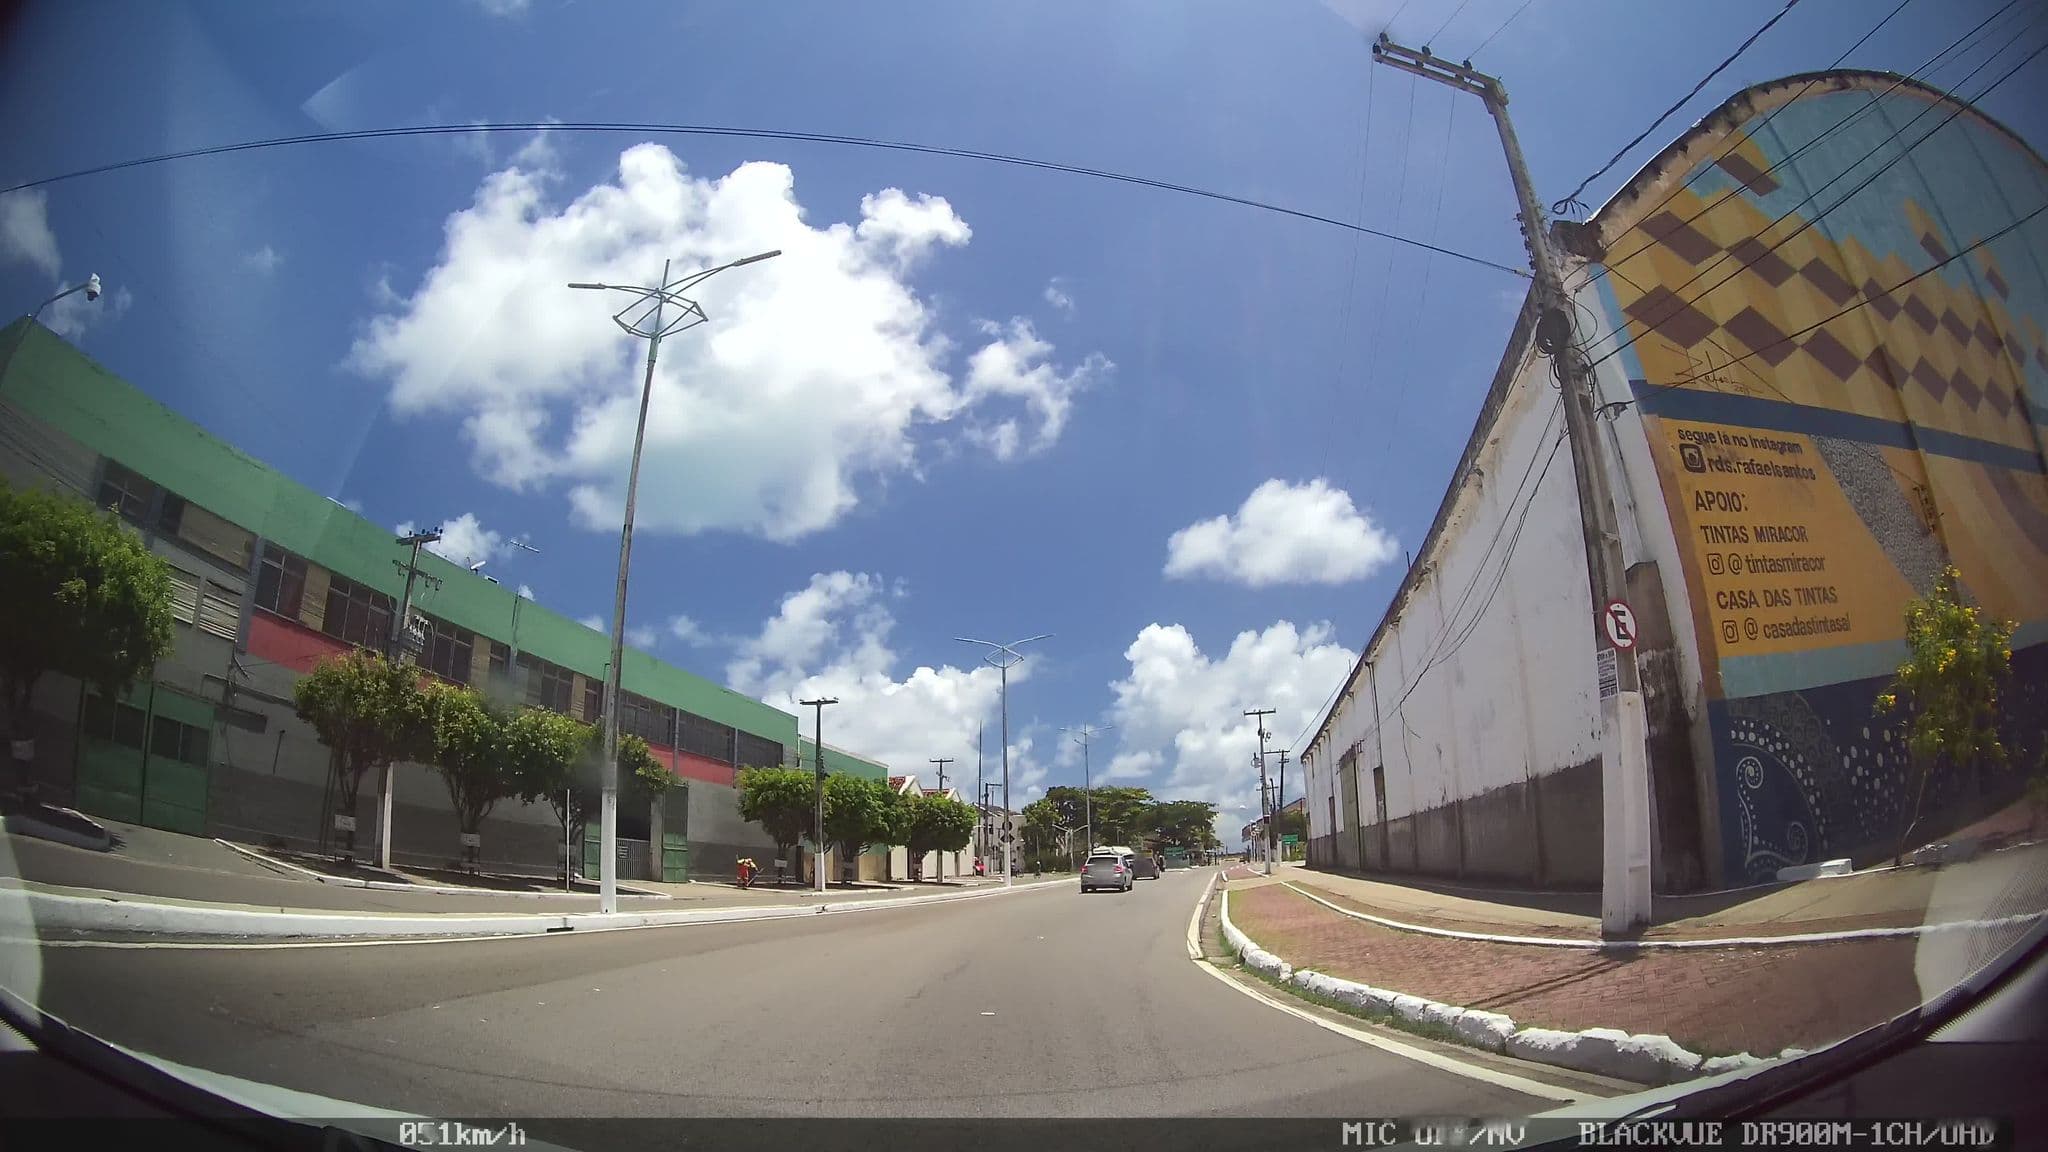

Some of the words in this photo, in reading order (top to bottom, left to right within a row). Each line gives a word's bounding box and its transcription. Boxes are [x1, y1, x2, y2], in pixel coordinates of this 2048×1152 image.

[1678, 428, 1717, 445] segue
[1733, 435, 1748, 448] no
[1695, 490, 1748, 512] APOIO:
[1700, 525, 1749, 544] TINTAS
[1755, 526, 1808, 544] MIRACOR
[1717, 590, 1760, 610] CASA
[1763, 589, 1792, 608] DAS
[1794, 586, 1838, 606] TINTAS
